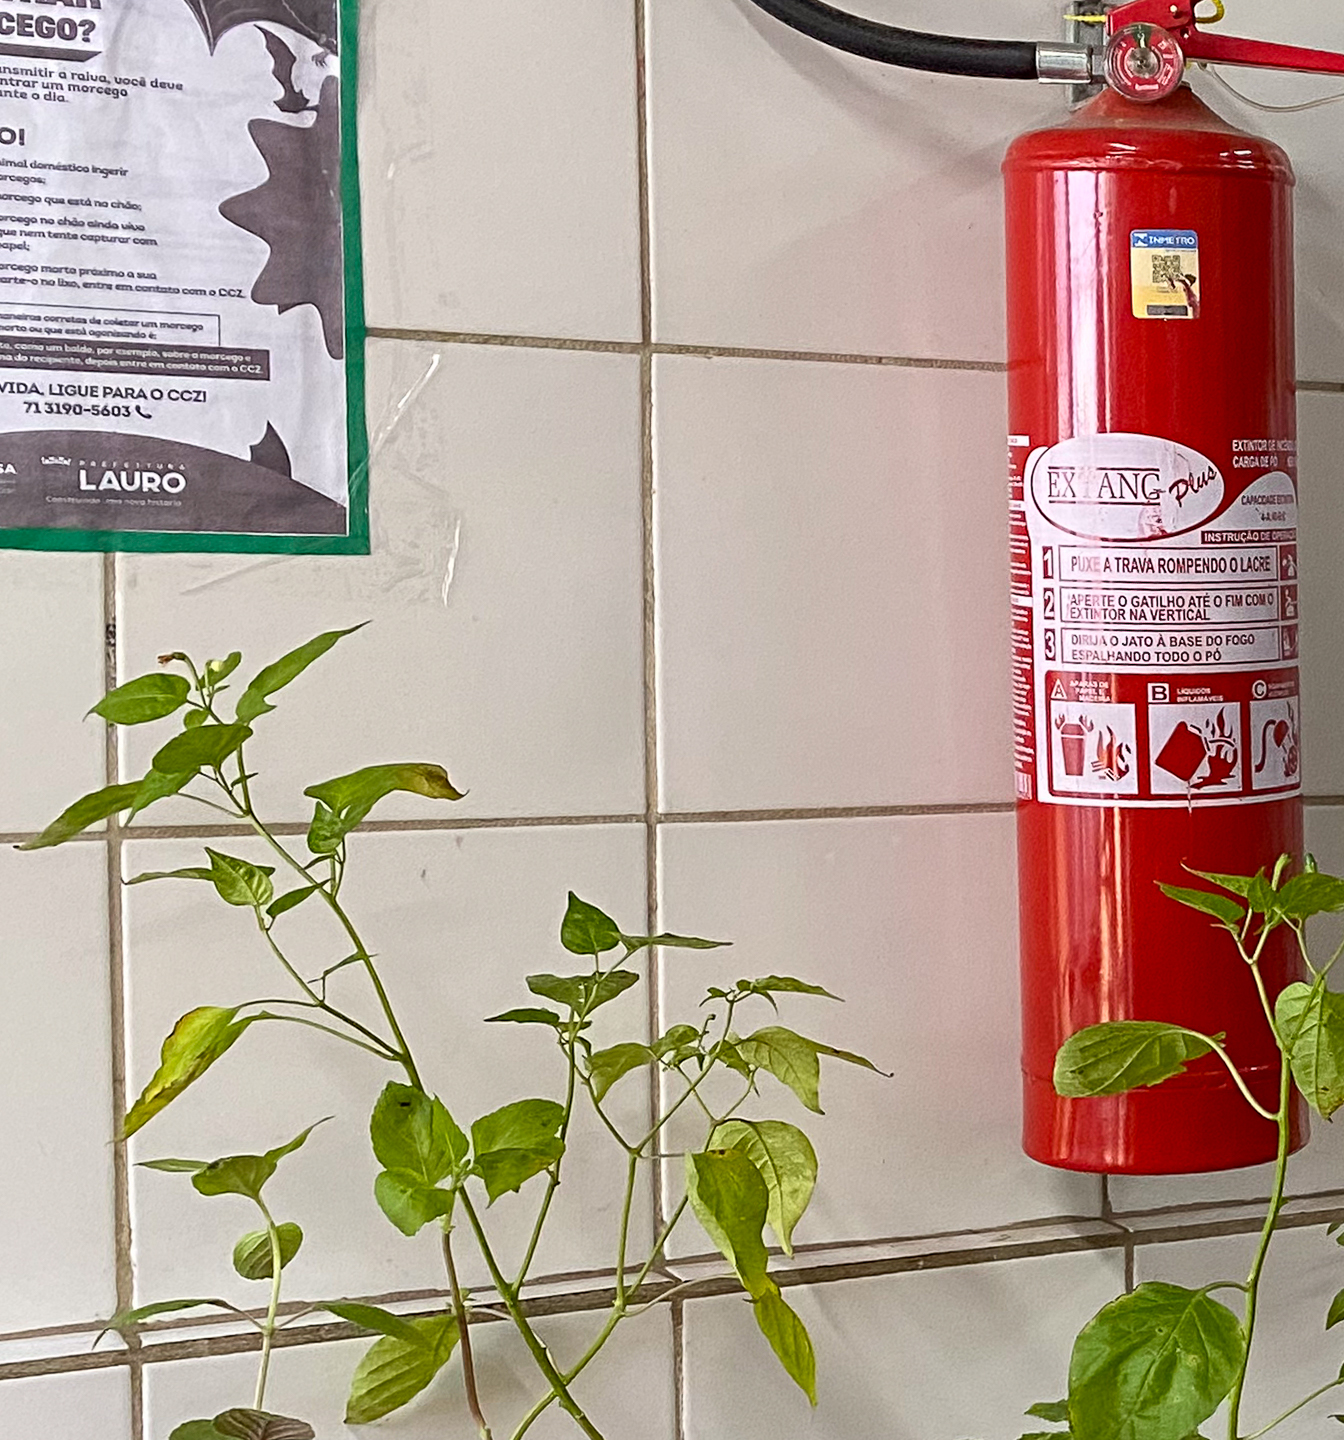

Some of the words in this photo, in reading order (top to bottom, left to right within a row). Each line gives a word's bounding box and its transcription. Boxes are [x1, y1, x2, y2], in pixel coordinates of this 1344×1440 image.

[59, 71, 67, 80] a
[71, 71, 110, 84] raiva,
[114, 75, 146, 88] você
[150, 77, 183, 91] deve
[31, 92, 40, 100] o
[43, 91, 69, 103] dia.
[41, 82, 64, 91] um
[68, 82, 128, 99] morcego
[30, 159, 90, 173] doméstico
[91, 164, 129, 178] ingerir
[44, 196, 65, 206] que
[67, 197, 92, 207] está
[57, 216, 85, 228] chão
[86, 219, 119, 230] ainda
[121, 222, 146, 231] vivo
[20, 229, 46, 238] nem
[48, 230, 78, 240] tente
[80, 233, 131, 243] capturar
[132, 235, 158, 246] com
[1148, 234, 1196, 246] INMETRO
[41, 265, 76, 275] morto
[79, 266, 125, 278] próximo
[127, 270, 135, 278] a
[136, 271, 157, 280] sua
[41, 278, 55, 287] no
[82, 281, 113, 290] entre
[115, 284, 133, 292] em
[135, 283, 180, 295] contato
[182, 286, 207, 296] com
[44, 327, 63, 335] que
[89, 317, 101, 325] de
[160, 322, 204, 333] morcego
[14, 343, 44, 352] como
[45, 345, 63, 353] um
[96, 348, 114, 356] por
[200, 353, 244, 364] morcego
[119, 360, 148, 368] entre
[149, 361, 165, 369] em
[166, 361, 207, 371] contato
[208, 364, 231, 372] com
[49, 383, 99, 398] LIGUE
[102, 386, 147, 400] PARA
[151, 389, 164, 401] O
[23, 401, 42, 414] 71
[44, 402, 132, 417] 3190-5603
[79, 460, 187, 471] PREFEITURA
[1232, 456, 1259, 468] CARGA
[79, 469, 188, 494] LAURO
[1168, 465, 1218, 509] Plus
[1204, 529, 1259, 543] INSTRUÇÃO
[1103, 557, 1112, 573] A
[1115, 556, 1155, 574] TRAVA
[1157, 557, 1226, 574] ROMPENDO
[1229, 557, 1238, 573] O
[1240, 555, 1271, 573] LACRE
[1070, 593, 1115, 608] APERTE
[1118, 595, 1128, 608] O
[1131, 595, 1186, 609] GATILHO
[1188, 592, 1211, 608] ATÉ
[1213, 594, 1223, 607] O
[1225, 594, 1243, 607] FIM
[1245, 594, 1266, 606] COM
[1267, 593, 1274, 606] O
[1070, 607, 1126, 621] EXTINTOR
[1129, 608, 1148, 621] NA
[1150, 609, 1210, 621] VERTICAL
[1110, 635, 1118, 646] O
[1122, 635, 1153, 647] JATO
[1169, 635, 1203, 648] BASE
[1206, 634, 1223, 646] DO
[1225, 633, 1255, 646] FOGO
[1071, 650, 1151, 662] ESPALHANDO
[1154, 651, 1190, 663] TODO
[1193, 651, 1203, 663] O
[1205, 648, 1222, 662] PÓ
[1151, 685, 1167, 700] B
[1254, 681, 1266, 697] C
